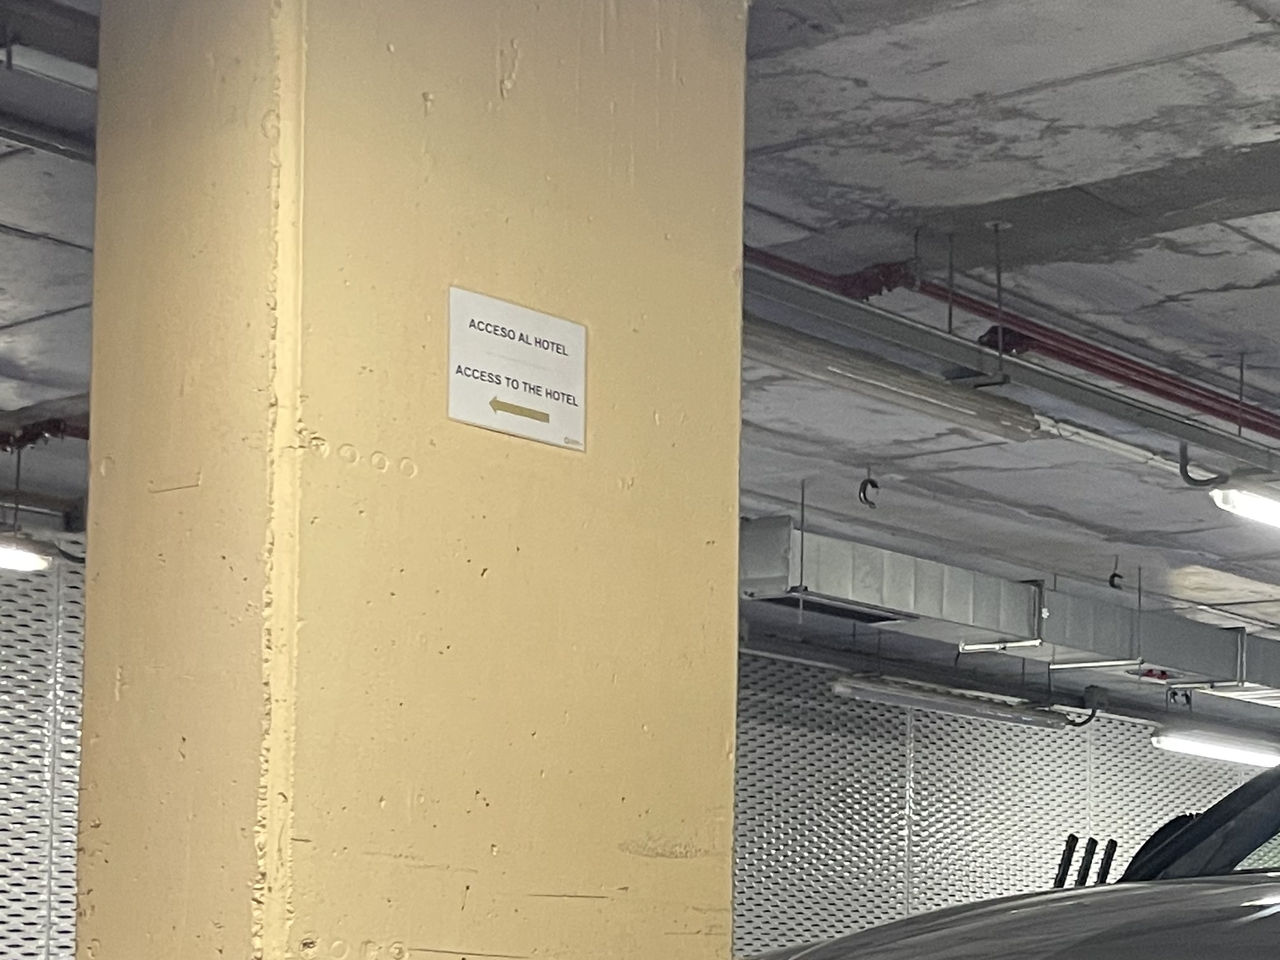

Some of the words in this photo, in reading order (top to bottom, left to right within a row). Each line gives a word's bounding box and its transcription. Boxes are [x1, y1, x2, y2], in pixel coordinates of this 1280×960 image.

[468, 318, 516, 341] ACCESO
[518, 332, 532, 346] AL
[534, 336, 569, 357] HOTEL
[455, 364, 502, 385] ACCESS
[504, 376, 520, 390] TO
[522, 381, 543, 397] THE
[545, 388, 579, 407] HOTEL
